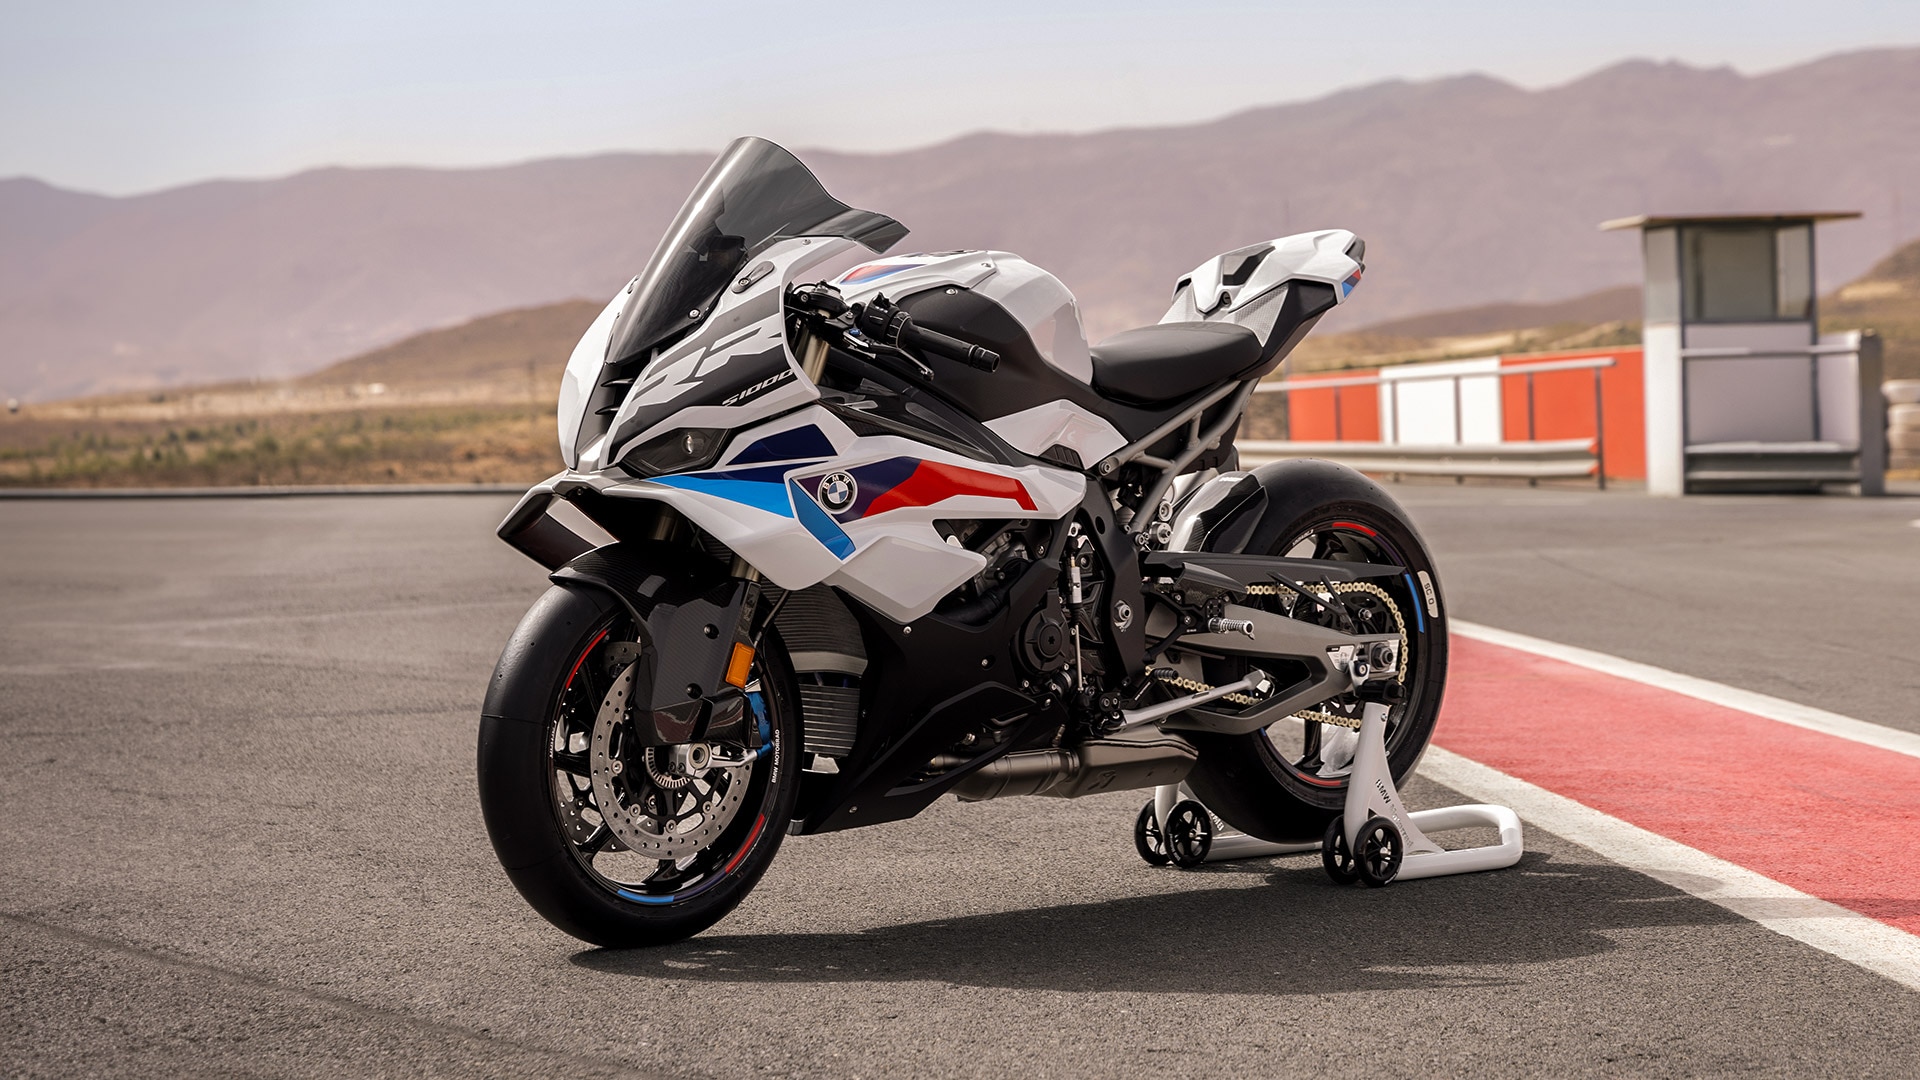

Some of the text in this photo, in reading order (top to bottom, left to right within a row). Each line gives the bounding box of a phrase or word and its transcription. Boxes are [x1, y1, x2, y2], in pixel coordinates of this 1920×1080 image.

[722, 368, 794, 407] S1000
[1424, 582, 1433, 596] SC
[771, 766, 779, 784] BMW
